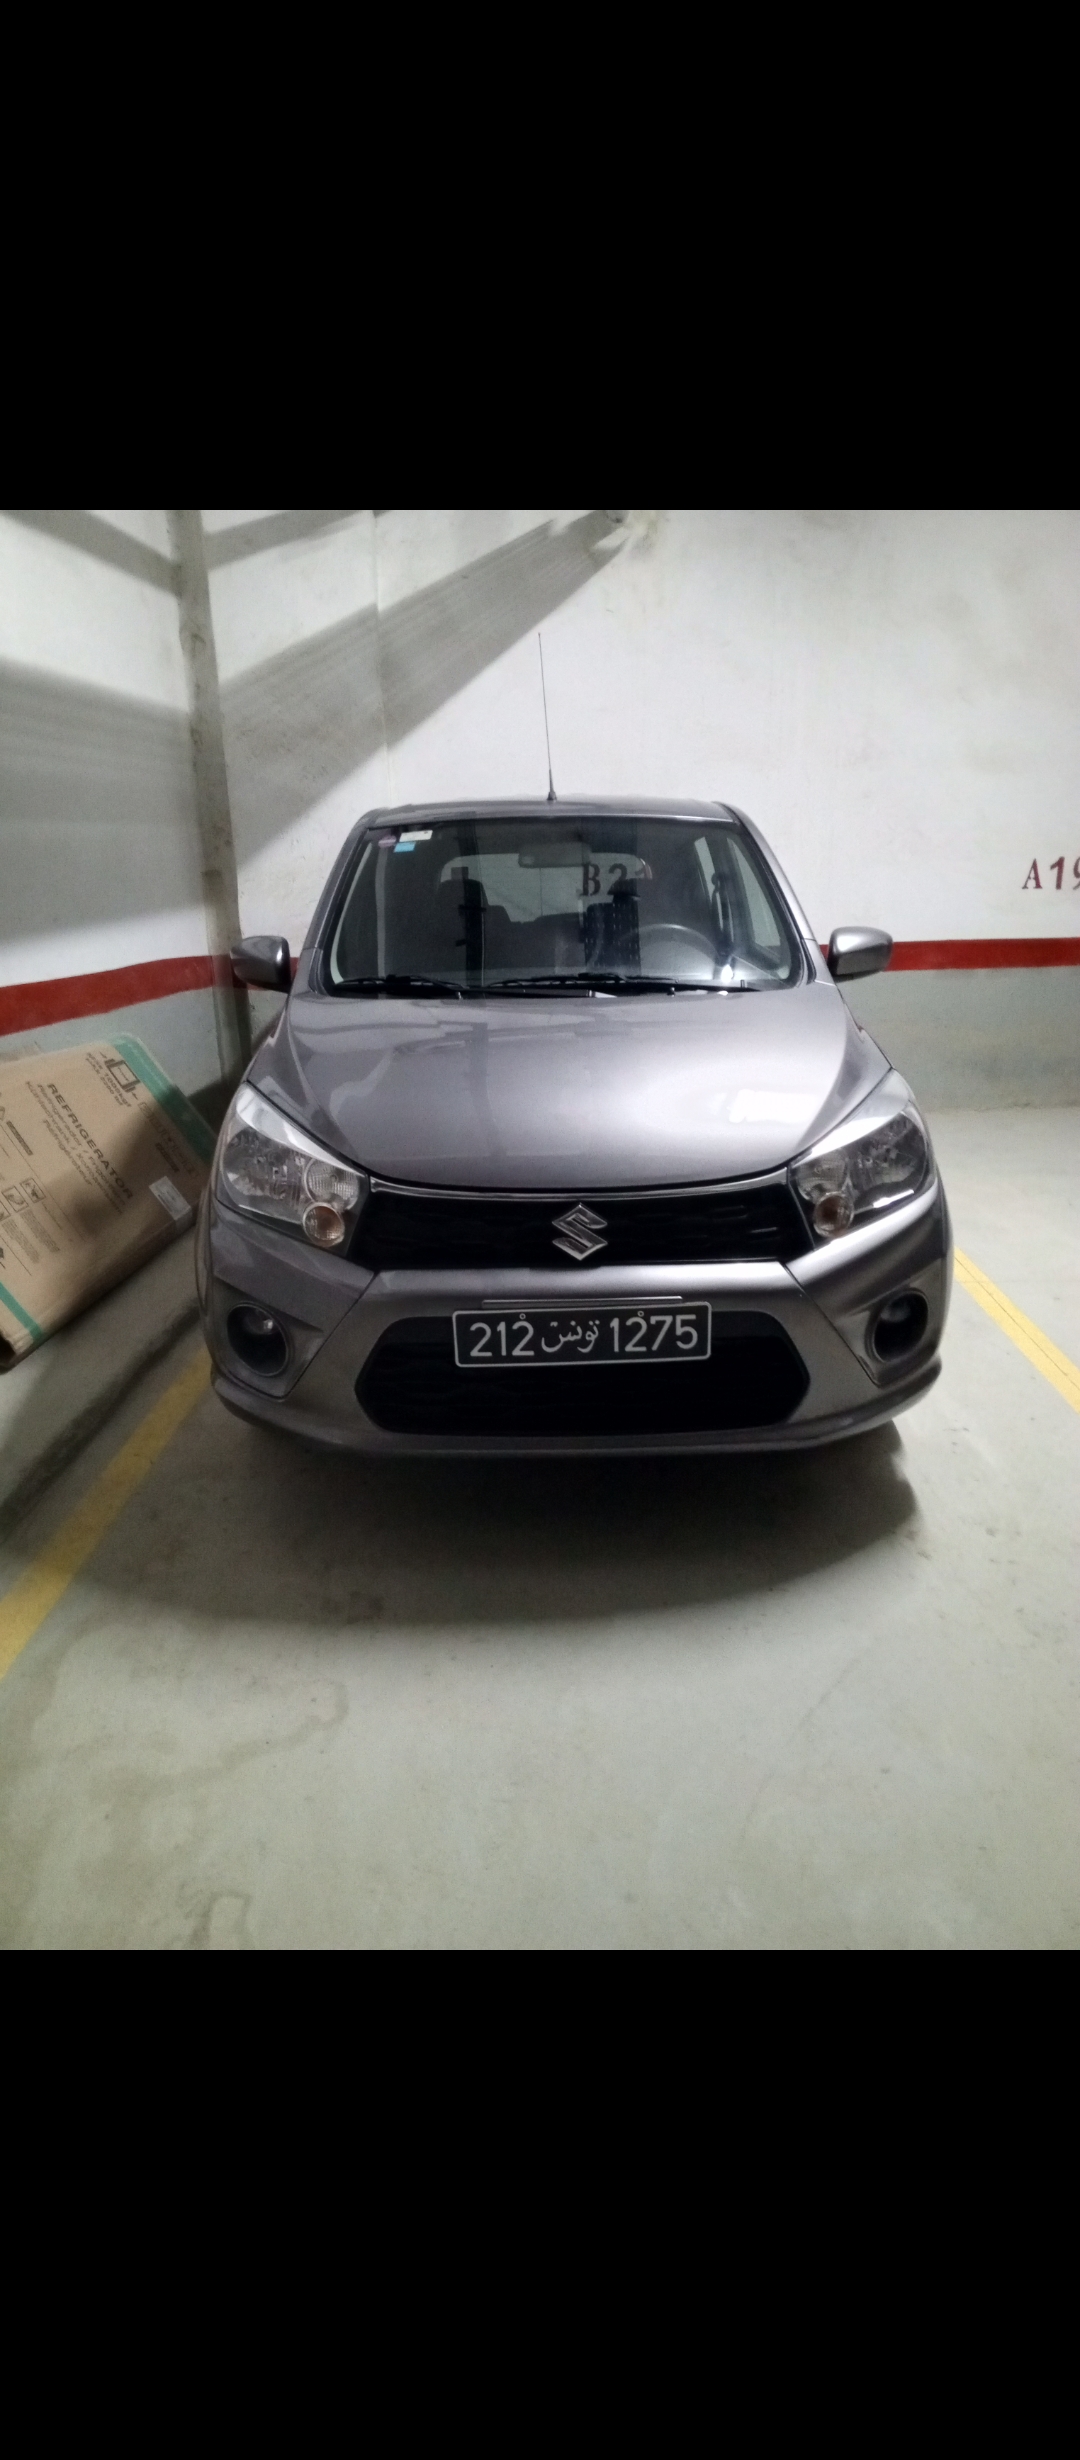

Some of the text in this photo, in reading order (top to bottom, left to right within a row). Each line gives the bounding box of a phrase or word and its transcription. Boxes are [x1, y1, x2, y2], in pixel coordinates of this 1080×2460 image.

[46, 1084, 134, 1199] REFRIGERATOR
[470, 1314, 698, 1357] 212 تونس 1275
